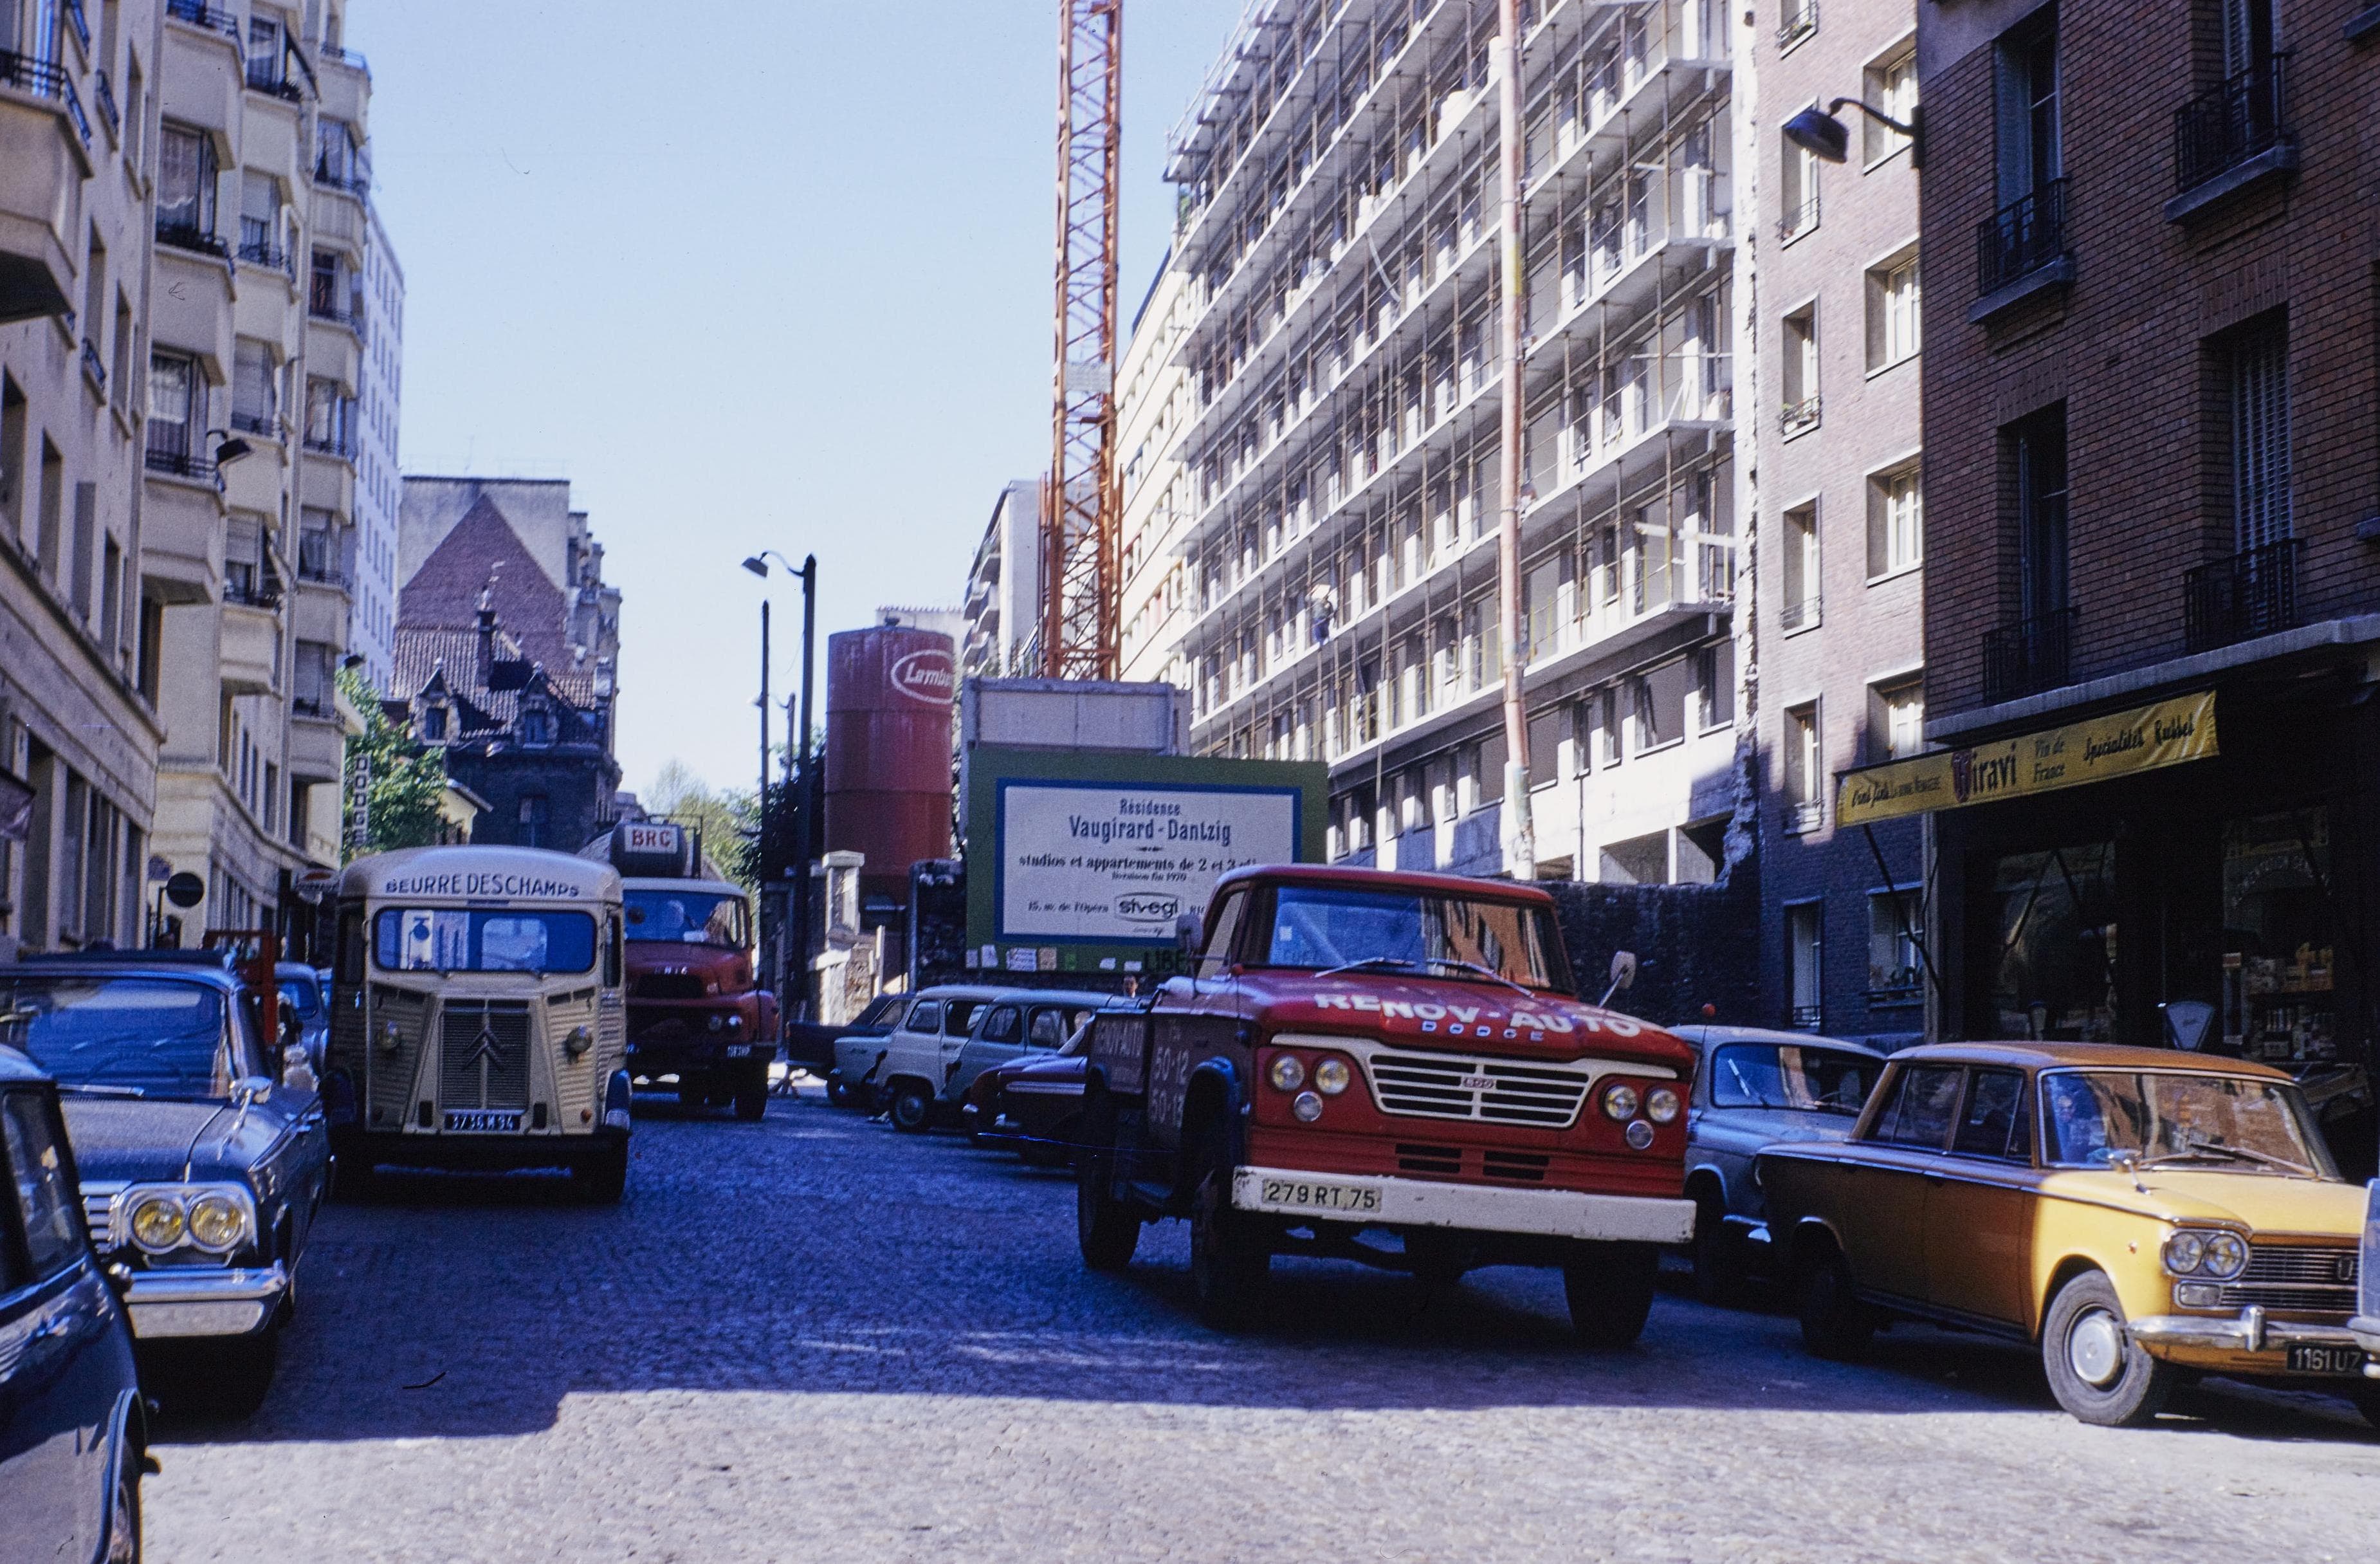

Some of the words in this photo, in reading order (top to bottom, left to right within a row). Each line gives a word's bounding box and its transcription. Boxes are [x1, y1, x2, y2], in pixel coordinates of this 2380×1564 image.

[1119, 798, 1181, 816] Résidence
[632, 829, 672, 847] BRC
[1068, 814, 1155, 844] Vaugirard
[1167, 818, 1231, 847] Dantzig
[1018, 852, 1066, 867] studios
[1070, 854, 1083, 867] et
[1086, 856, 1175, 872] appartements
[1179, 858, 1195, 871] de
[1198, 858, 1207, 872] 2
[1212, 860, 1224, 871] et
[385, 874, 462, 894] BEURRE
[466, 872, 580, 897] DESCHAMPS
[1313, 993, 1480, 1024] RENOV
[1510, 1011, 1641, 1038] AUTO
[1422, 1020, 1544, 1042] DODGE
[1268, 1182, 1309, 1204] 279
[1315, 1186, 1341, 1207] RT
[1351, 1189, 1375, 1209] 75
